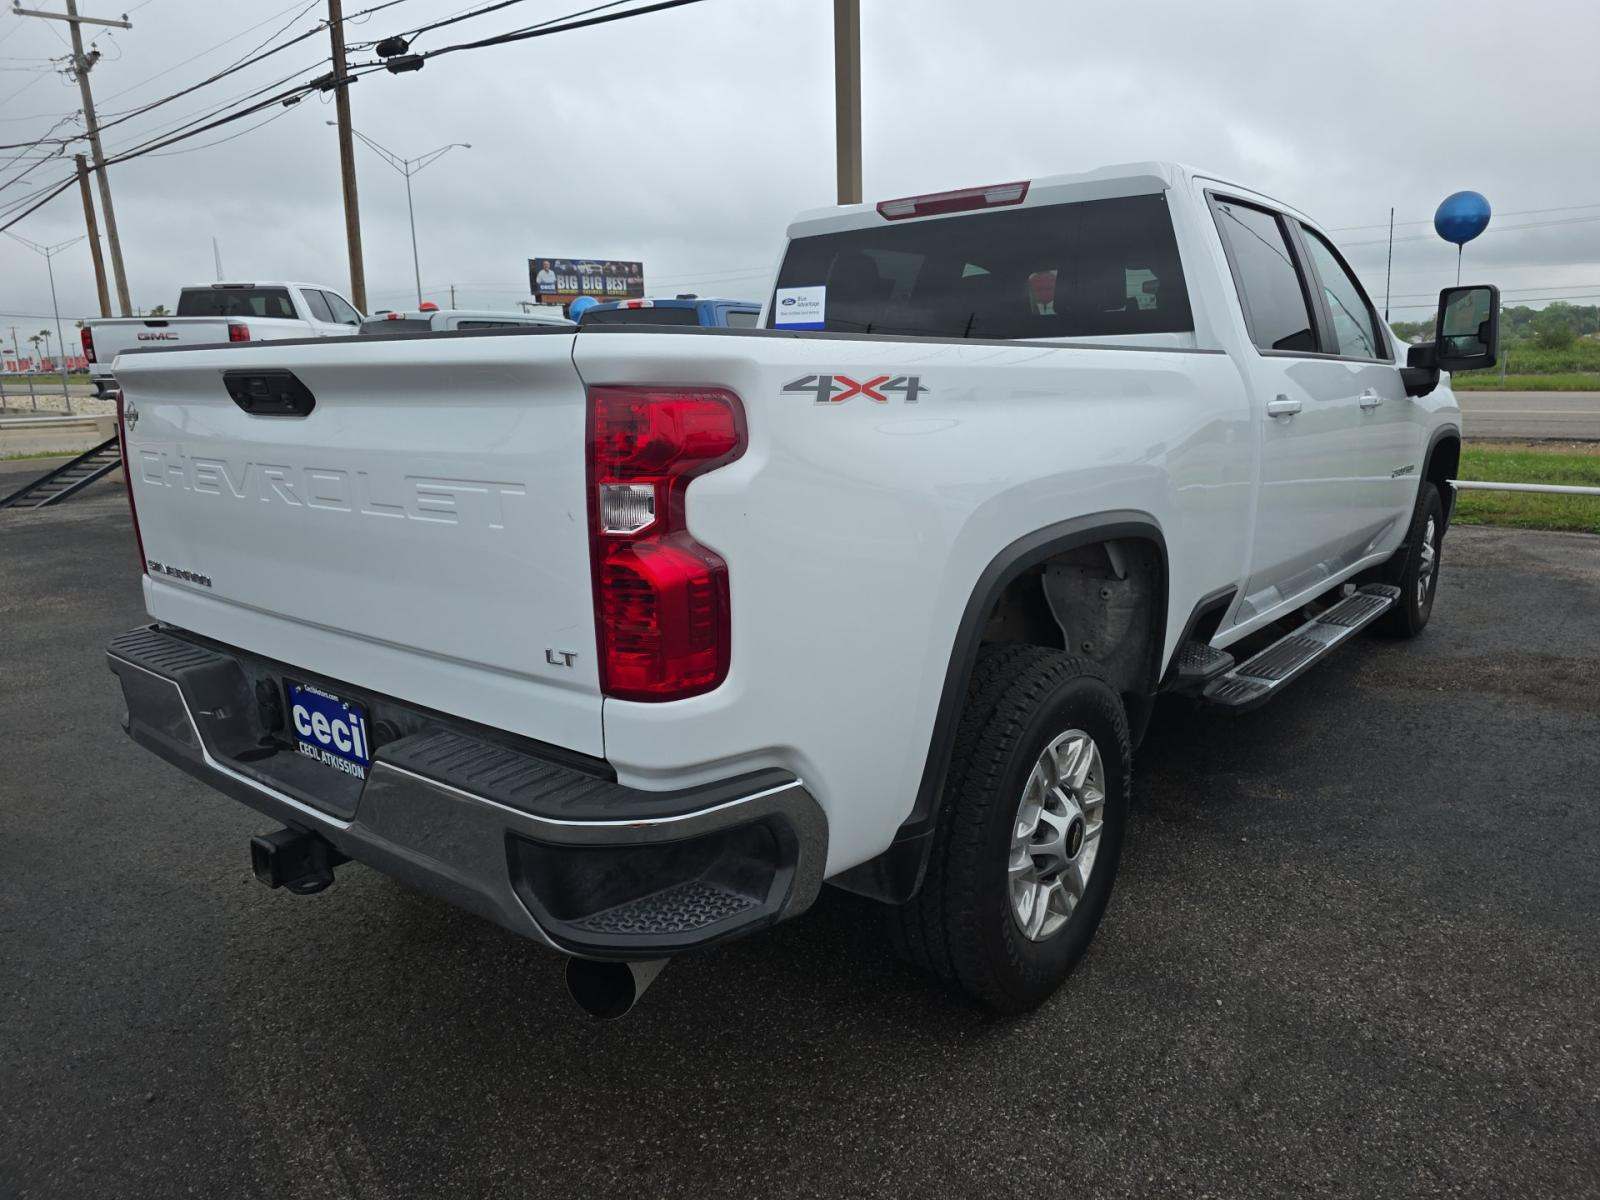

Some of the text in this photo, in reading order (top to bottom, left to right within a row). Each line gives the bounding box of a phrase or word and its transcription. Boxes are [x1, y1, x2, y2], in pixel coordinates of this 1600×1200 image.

[557, 275, 578, 290] BIG
[582, 276, 603, 290] BIG
[605, 276, 628, 291] BEST
[137, 332, 180, 341] GMC
[139, 449, 527, 530] CHEVROLET
[545, 648, 578, 668] LT
[292, 703, 369, 761] cecil
[299, 741, 366, 780] CECIL ATKISSION
